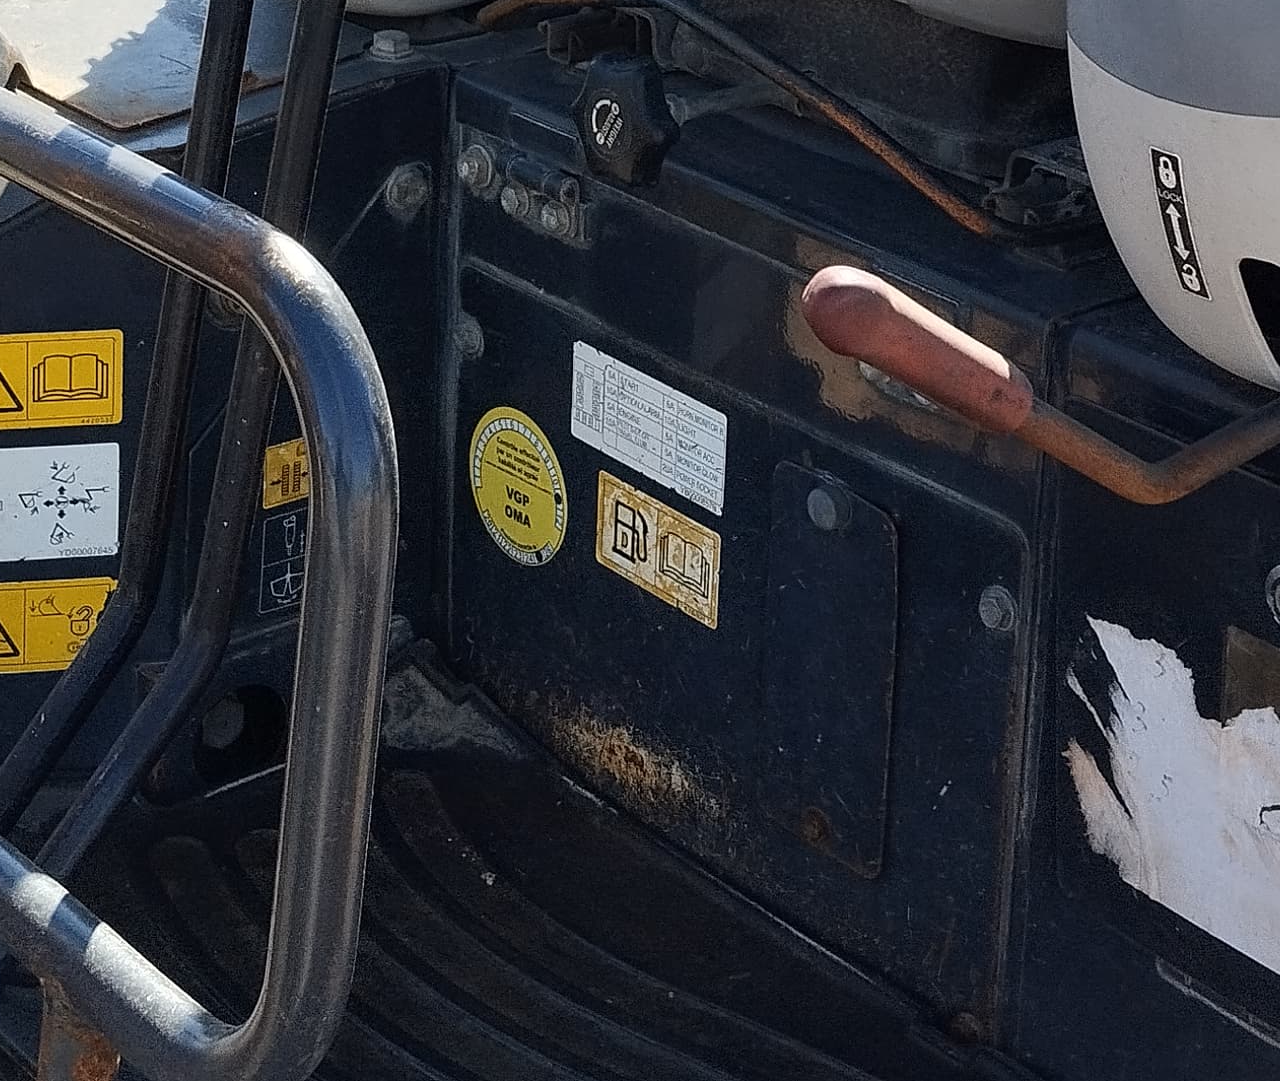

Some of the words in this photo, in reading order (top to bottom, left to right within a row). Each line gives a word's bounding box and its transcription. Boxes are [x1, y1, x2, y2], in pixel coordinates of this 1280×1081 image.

[1157, 187, 1184, 204] LOCK
[505, 484, 530, 507] VGP
[505, 504, 531, 529] OMA
